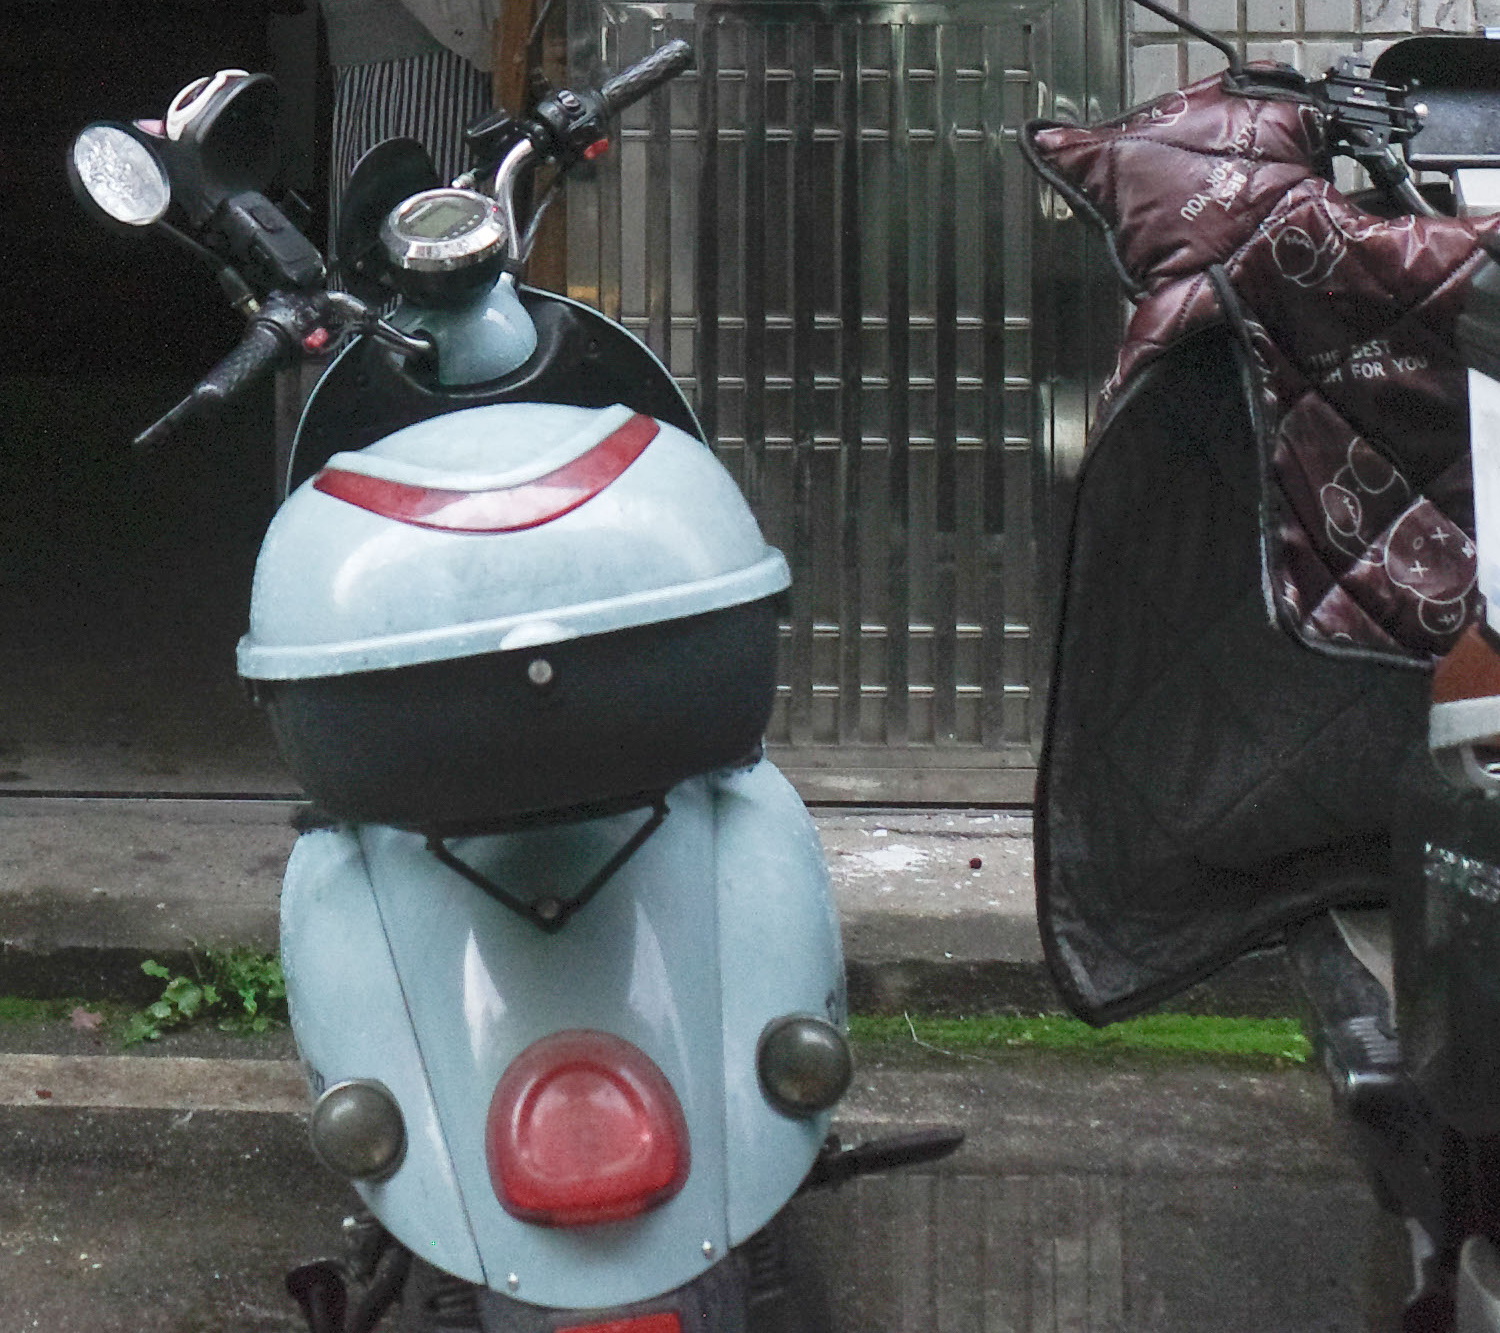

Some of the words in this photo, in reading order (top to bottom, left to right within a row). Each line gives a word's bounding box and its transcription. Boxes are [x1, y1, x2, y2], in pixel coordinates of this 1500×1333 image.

[1216, 170, 1248, 212] BEST
[1180, 193, 1212, 221] YOU
[1350, 361, 1386, 379] FOR
[1391, 355, 1428, 373] YOU
